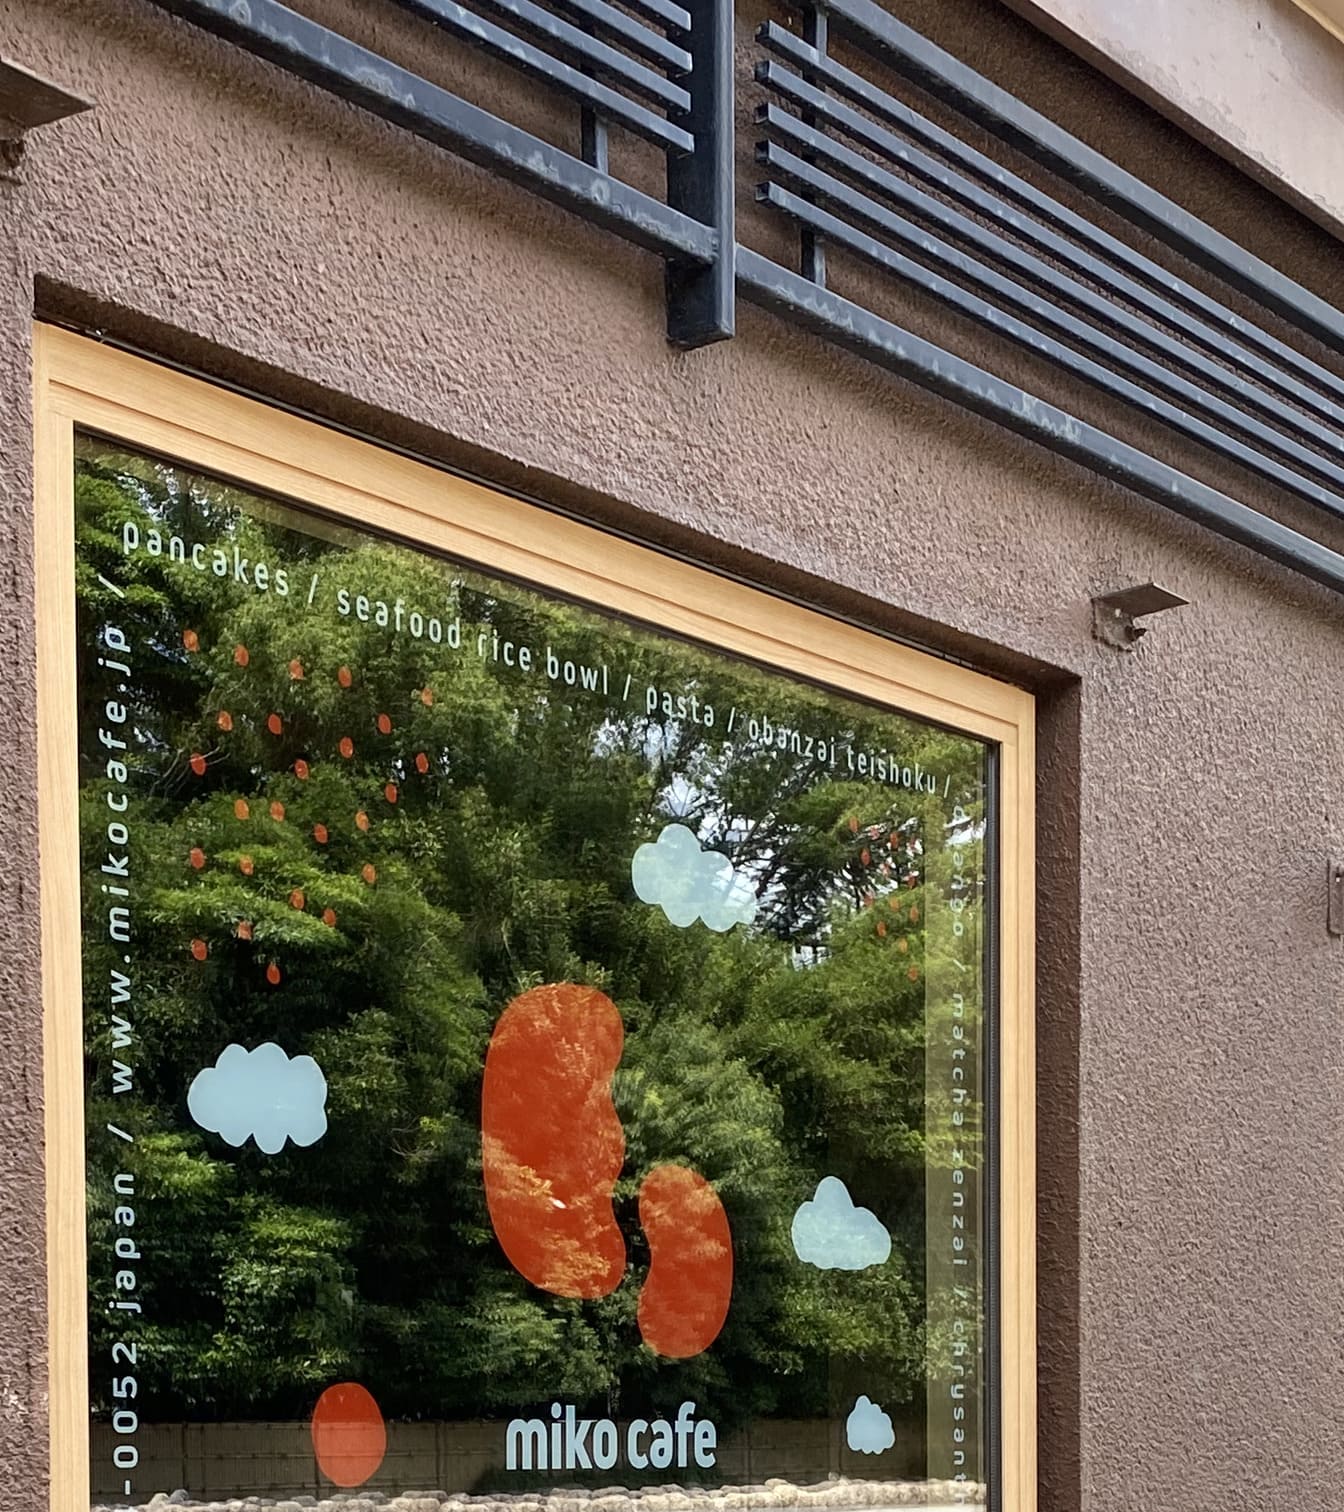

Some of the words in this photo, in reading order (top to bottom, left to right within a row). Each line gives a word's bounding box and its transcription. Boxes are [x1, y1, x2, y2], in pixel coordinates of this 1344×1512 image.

[123, 521, 289, 596] pancakes
[337, 588, 461, 649] seafood
[478, 629, 532, 672] rice
[546, 646, 608, 695] bowl
[646, 685, 714, 727] pasta
[749, 716, 835, 764] obanzai
[846, 746, 936, 794] teishoku
[97, 625, 134, 1094] www.mikocafe.jp
[952, 993, 967, 1126] matcha
[109, 1172, 142, 1314] japan
[952, 1149, 968, 1265] zenzai
[505, 1402, 618, 1471] miko
[627, 1400, 718, 1470] cafe
